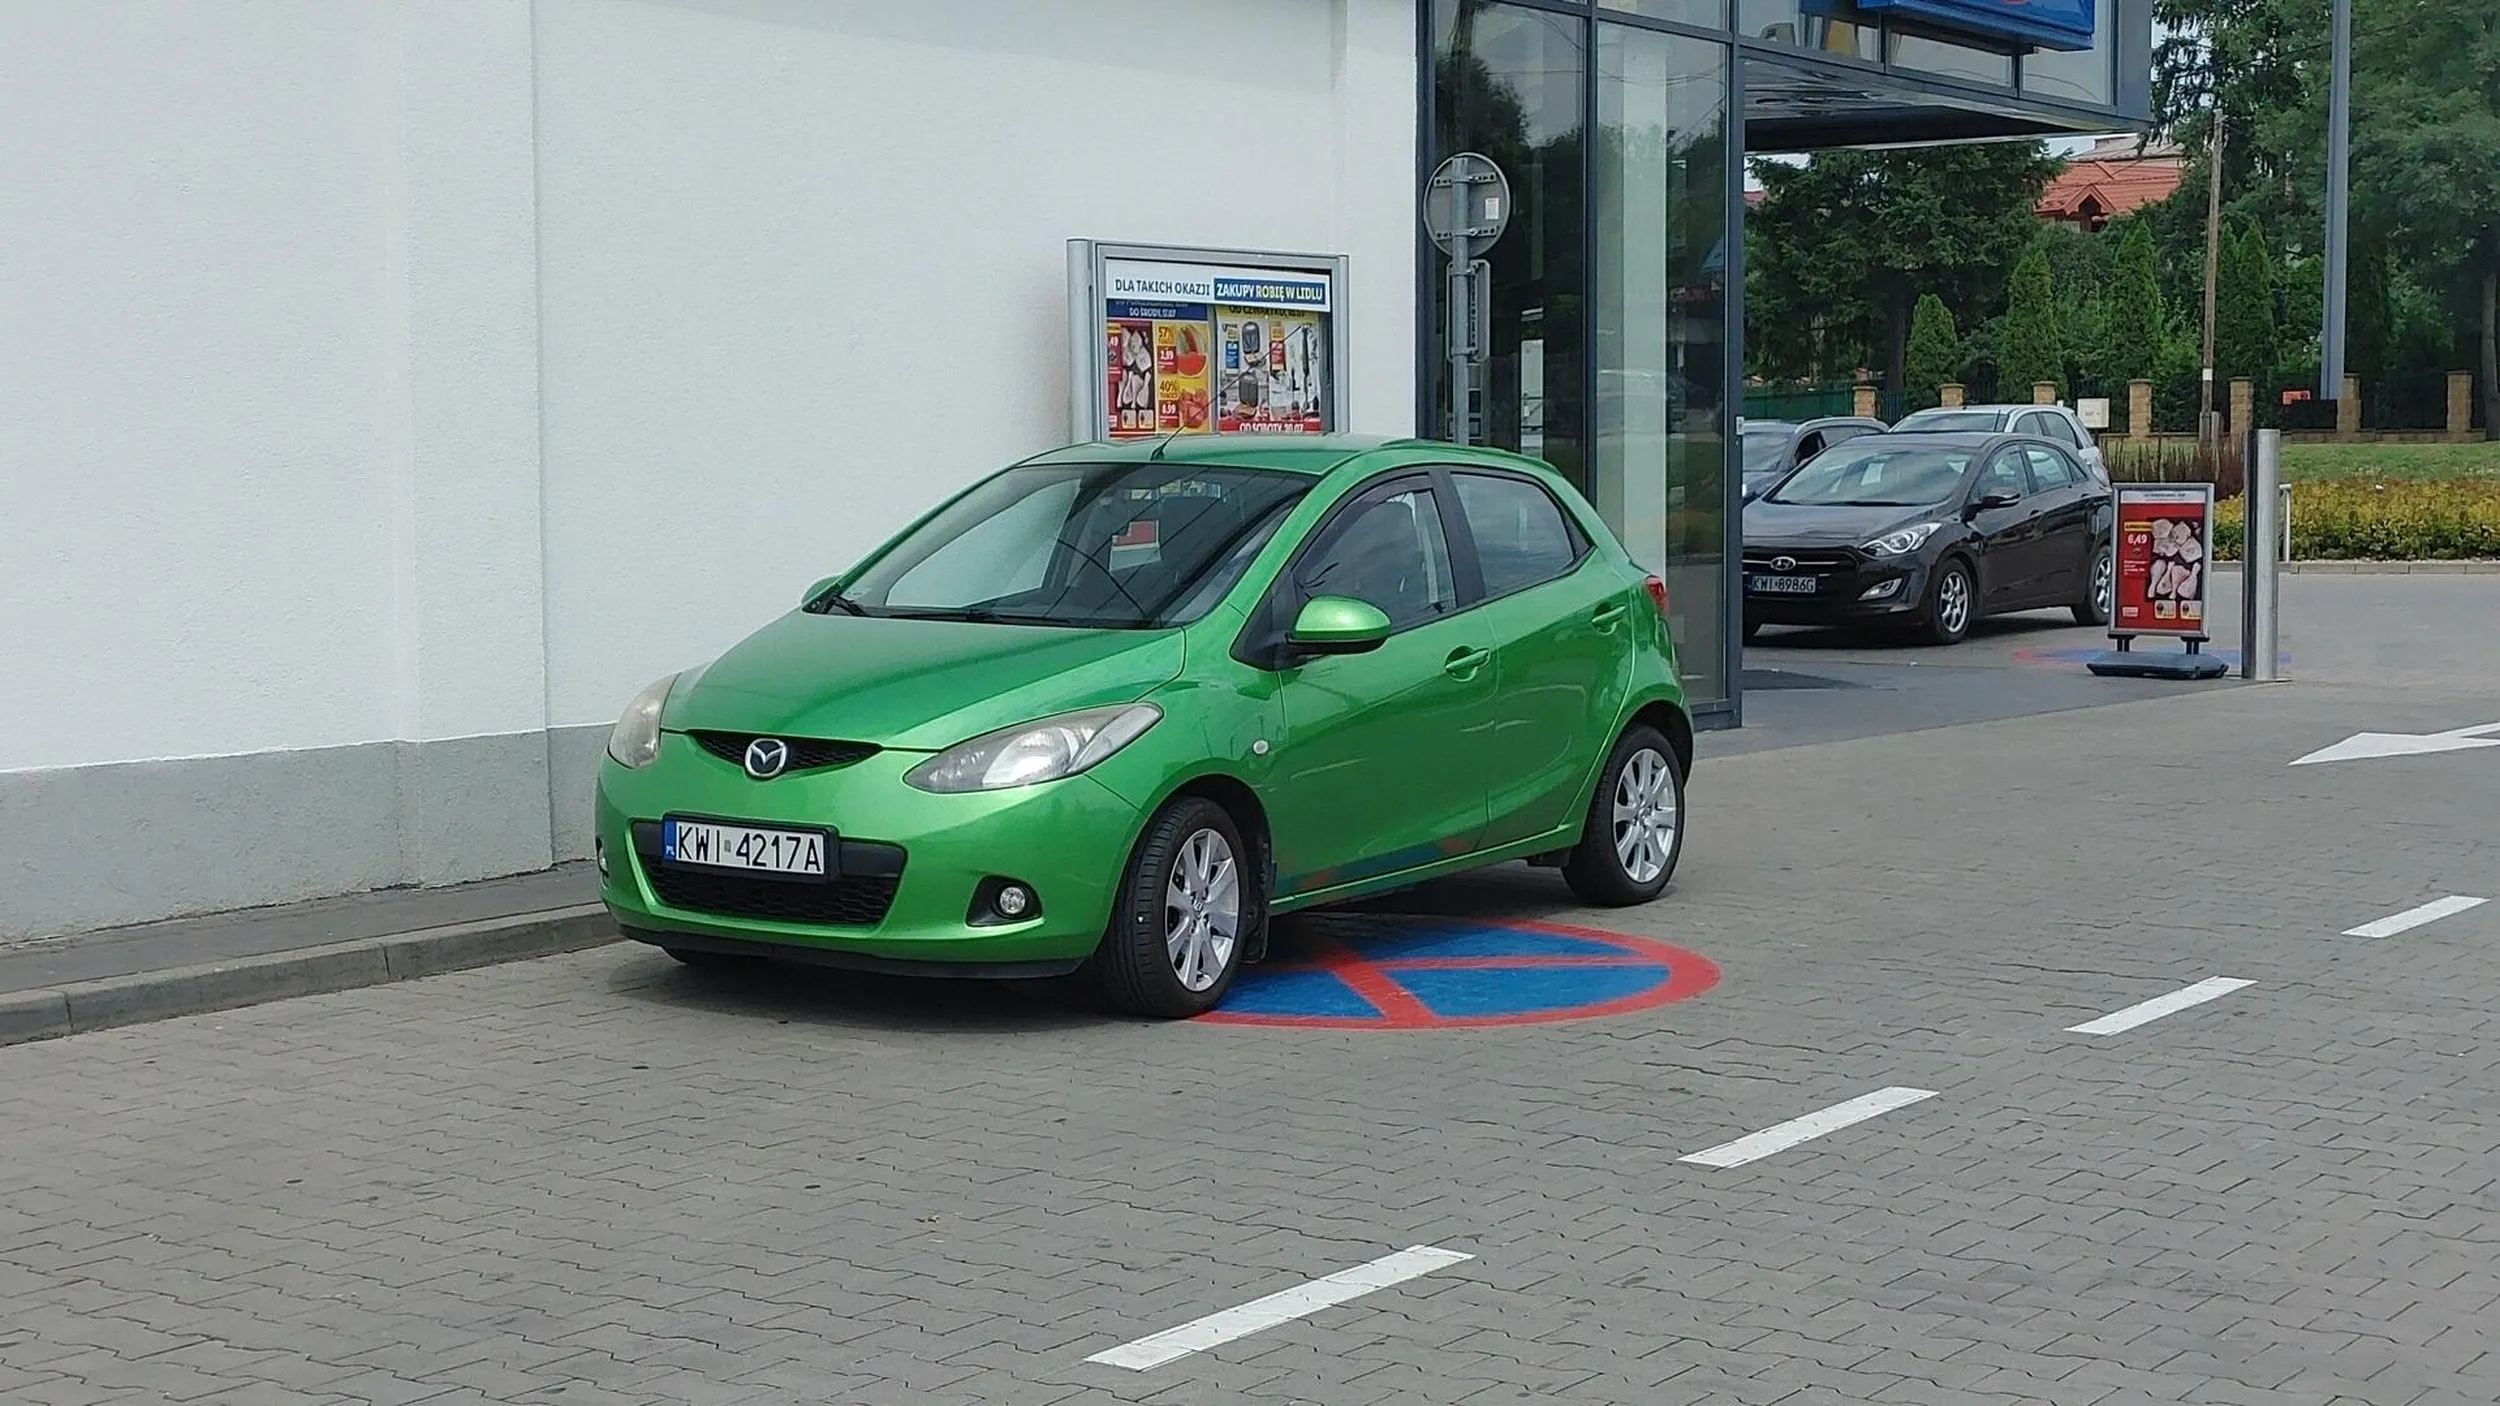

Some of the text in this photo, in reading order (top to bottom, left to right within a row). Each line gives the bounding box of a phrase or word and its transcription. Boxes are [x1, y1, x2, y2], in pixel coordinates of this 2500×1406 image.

[1115, 279, 1322, 301] DLA TAKICH OKAZJI ZAKUPY ROBIĘ W LIDLU
[2127, 533, 2148, 546] 6,49
[1753, 577, 1815, 592] KWI 8986G
[678, 825, 821, 872] KWI 4217A
